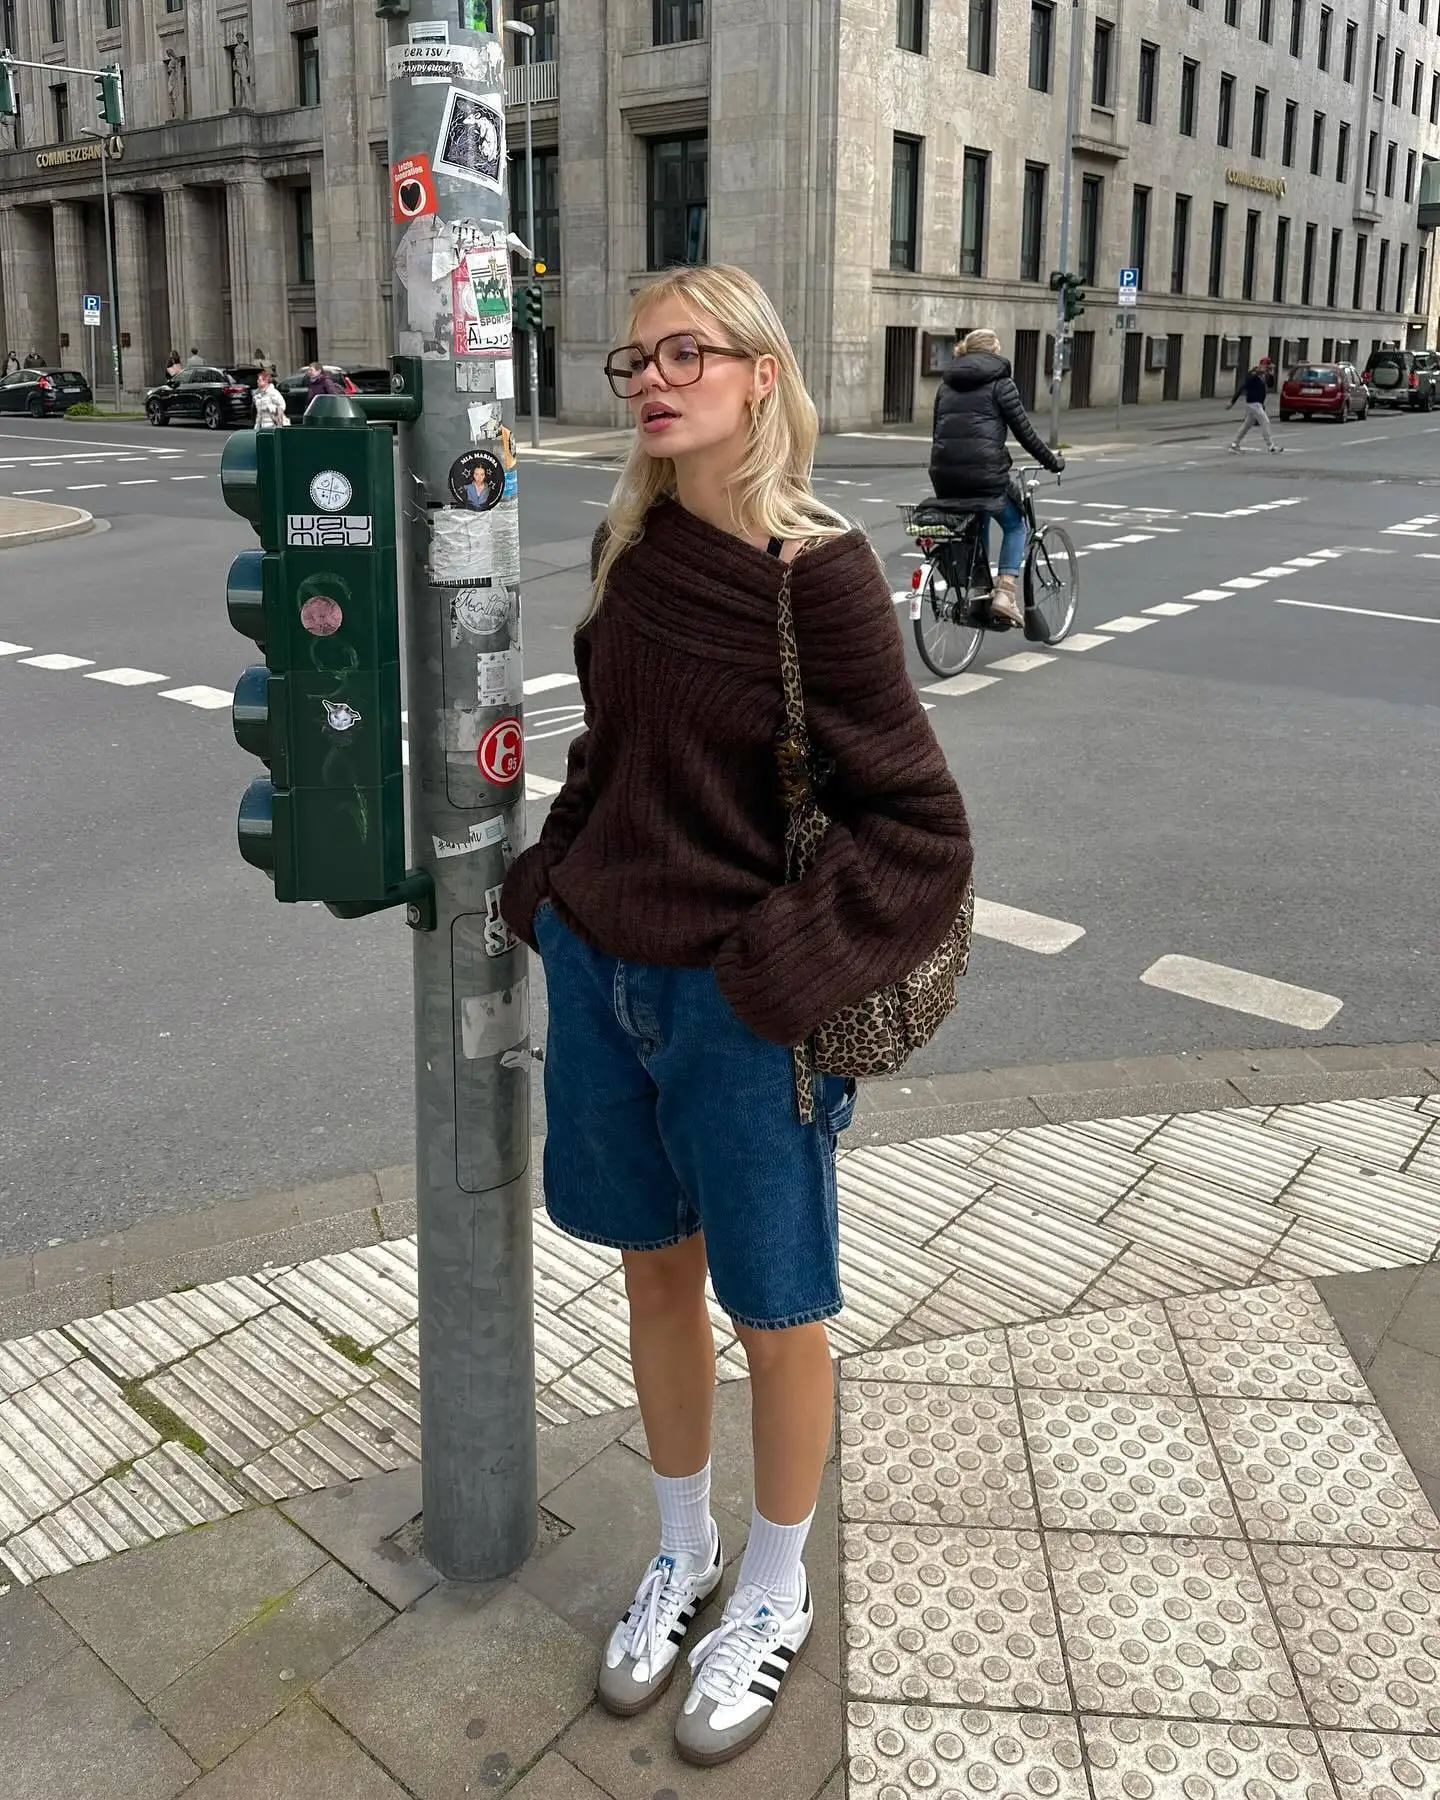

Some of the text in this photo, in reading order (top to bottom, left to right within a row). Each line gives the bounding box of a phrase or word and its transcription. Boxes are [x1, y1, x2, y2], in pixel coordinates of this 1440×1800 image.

[425, 47, 443, 57] TSV
[1123, 271, 1134, 286] P
[87, 297, 97, 310] P
[460, 454, 473, 465] MIA
[507, 757, 517, 771] 95
